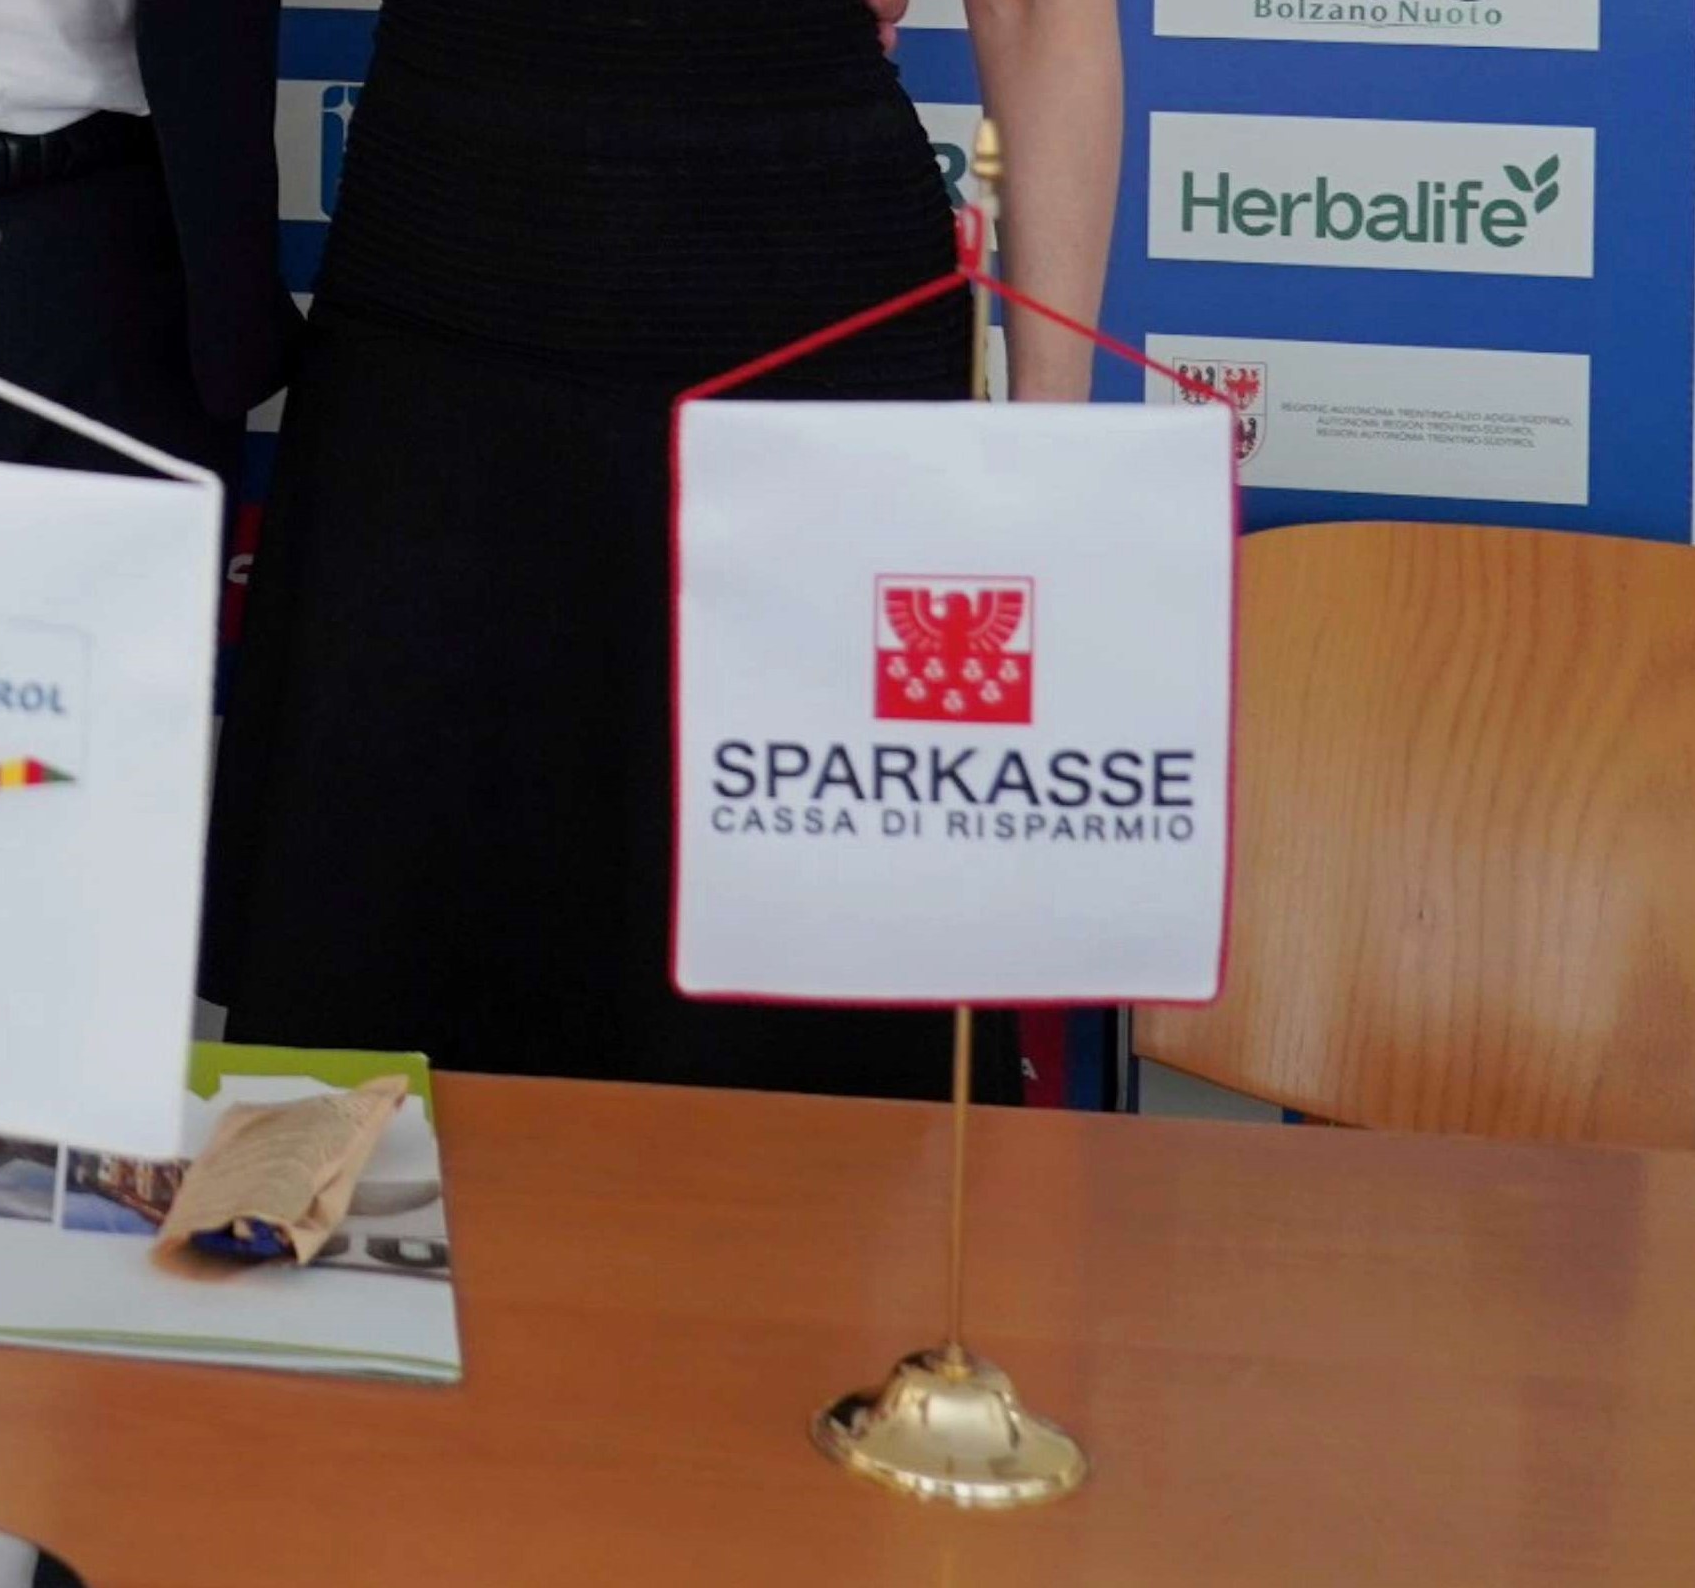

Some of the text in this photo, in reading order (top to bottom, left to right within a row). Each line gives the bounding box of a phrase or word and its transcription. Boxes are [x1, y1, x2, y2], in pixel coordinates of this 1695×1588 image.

[1398, 0, 1502, 26] Nuoto
[1181, 170, 1527, 248] Herbalife
[713, 739, 1196, 809] SPARKASSE
[711, 805, 1195, 843] CASSA DI RISPARMIO
